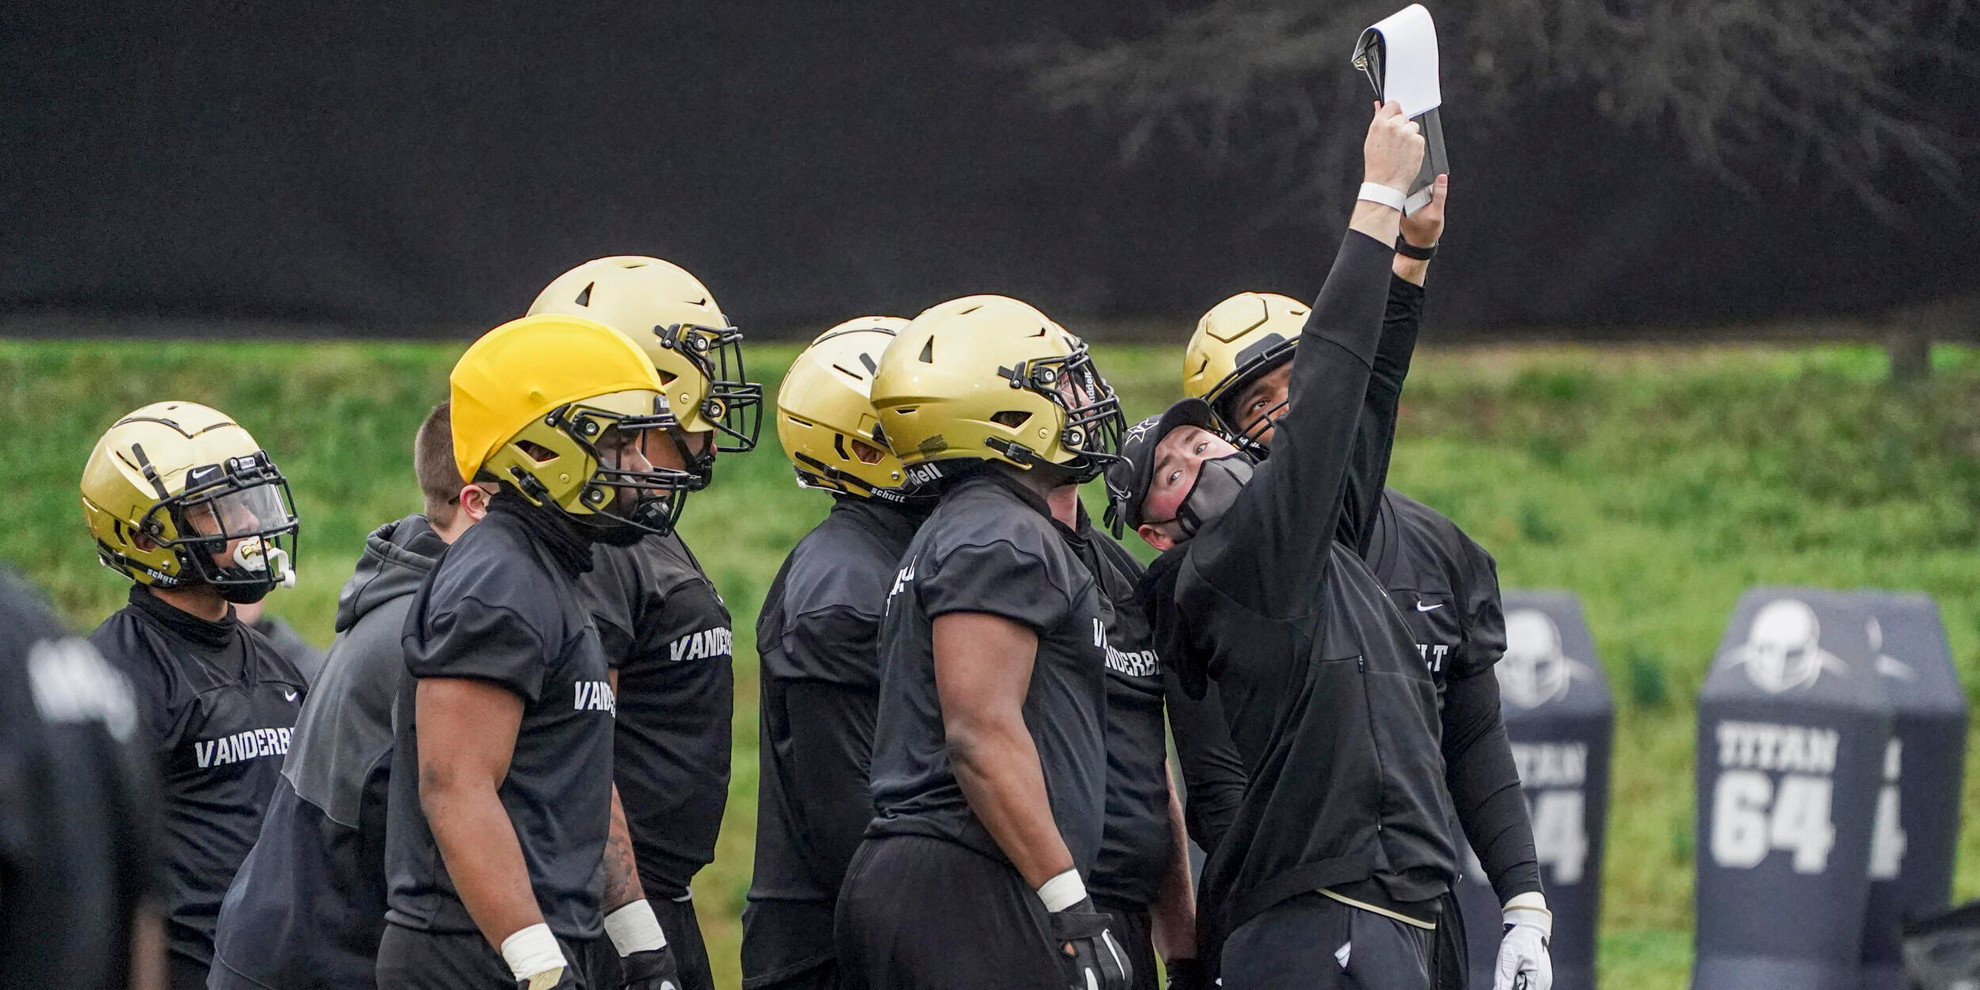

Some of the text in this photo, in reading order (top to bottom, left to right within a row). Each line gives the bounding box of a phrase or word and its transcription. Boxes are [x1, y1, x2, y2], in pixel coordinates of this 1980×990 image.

[870, 487, 906, 504] schutt
[146, 568, 178, 585] schutt
[194, 726, 295, 768] VANDERB
[1716, 719, 1840, 774] TITAN
[1710, 768, 1836, 876] 64
